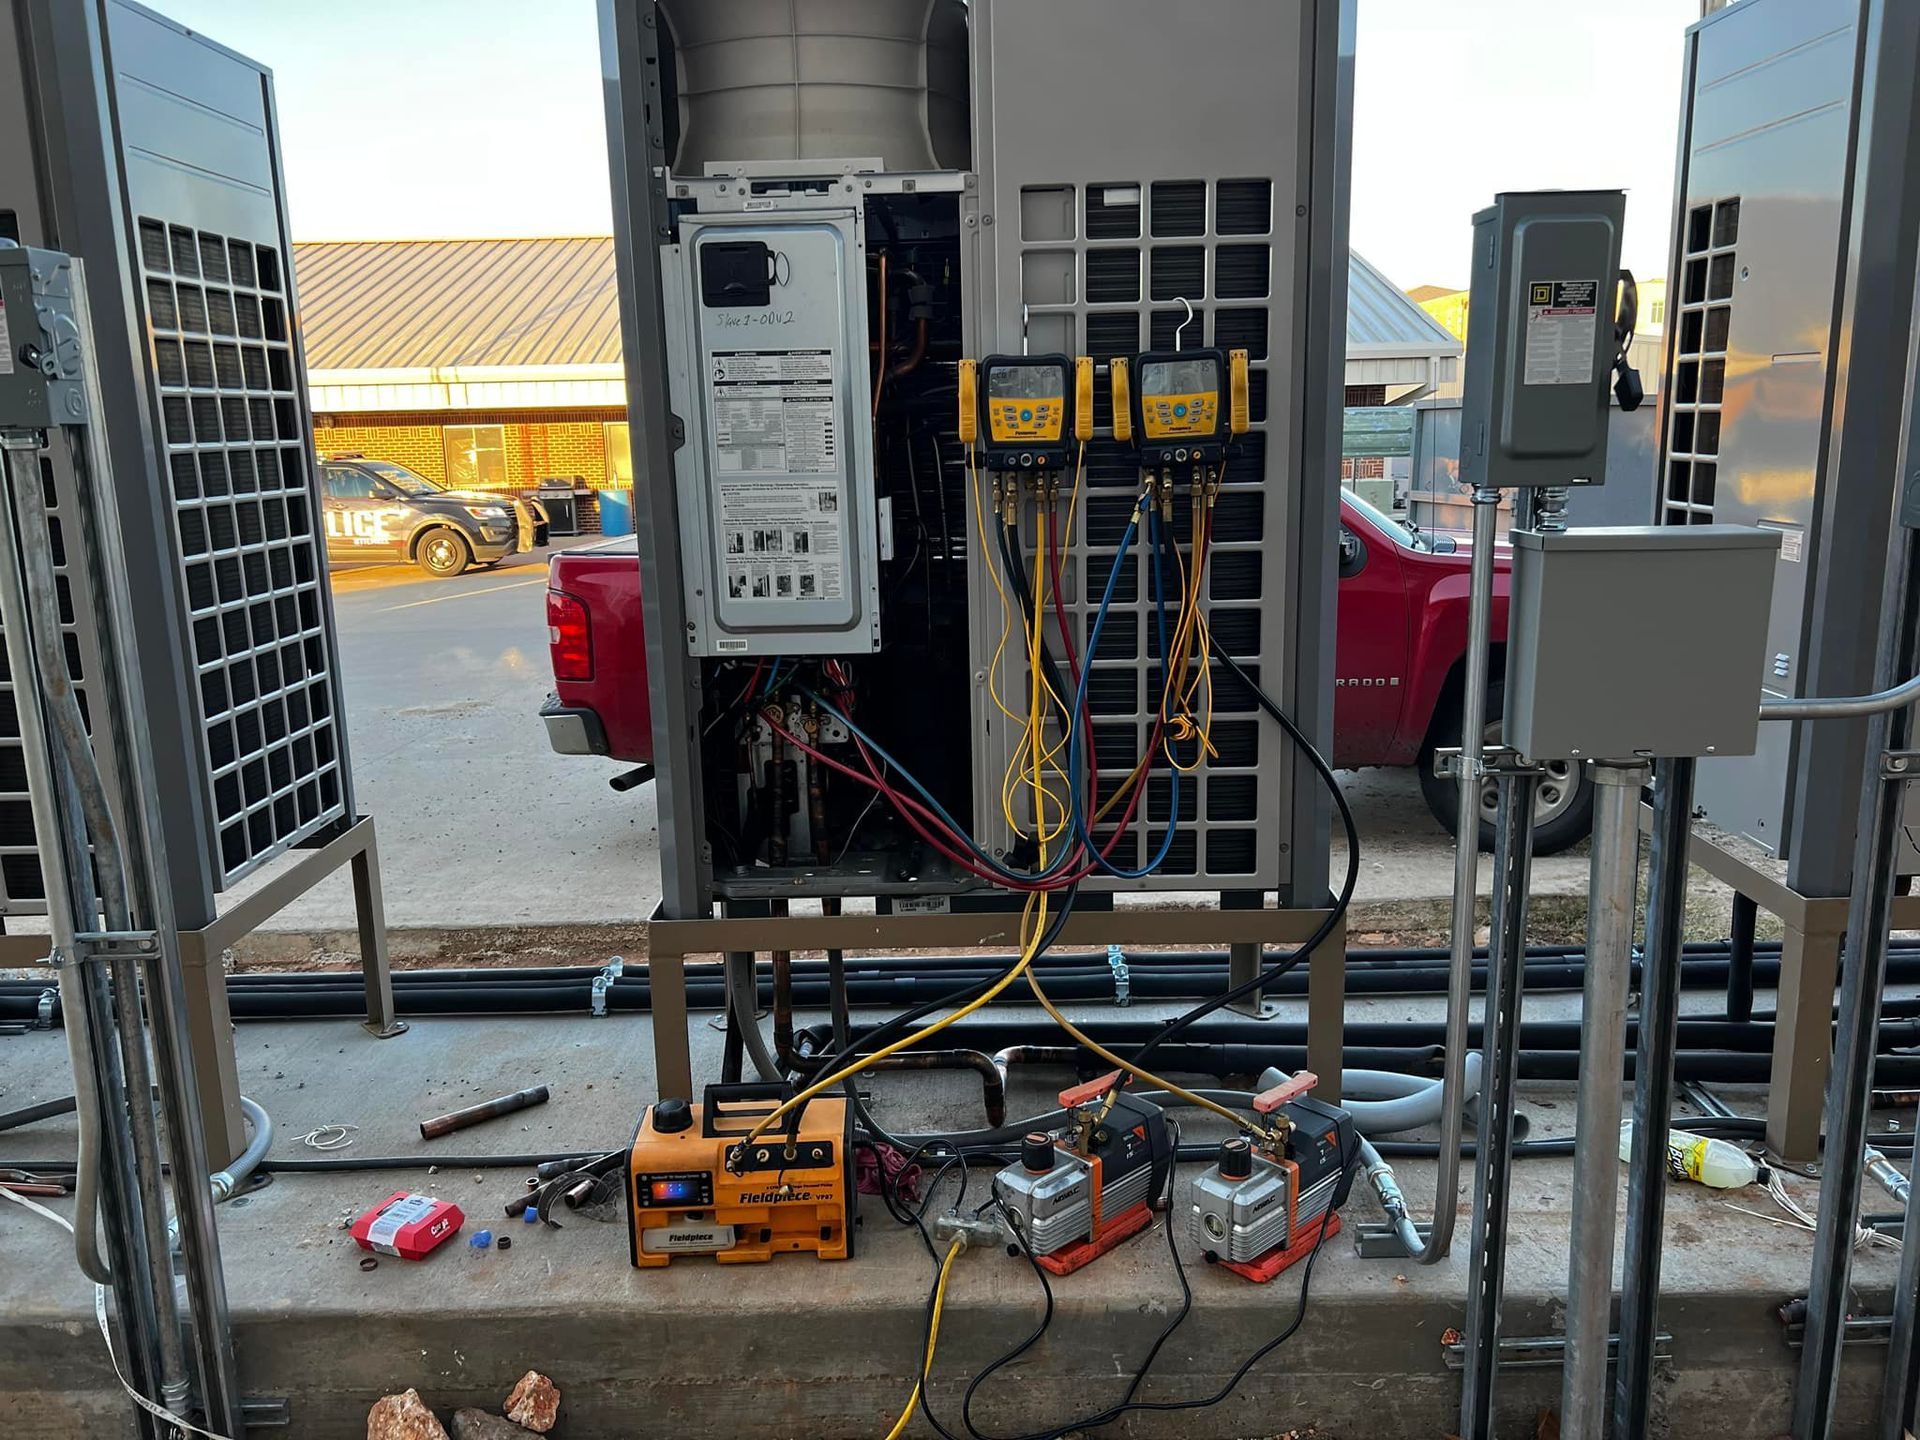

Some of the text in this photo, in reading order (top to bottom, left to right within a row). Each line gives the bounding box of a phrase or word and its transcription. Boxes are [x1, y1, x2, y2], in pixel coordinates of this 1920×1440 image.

[325, 510, 391, 538] LICE
[739, 1187, 811, 1205] Fieldpiece
[669, 1233, 713, 1243] Fieldpiece
